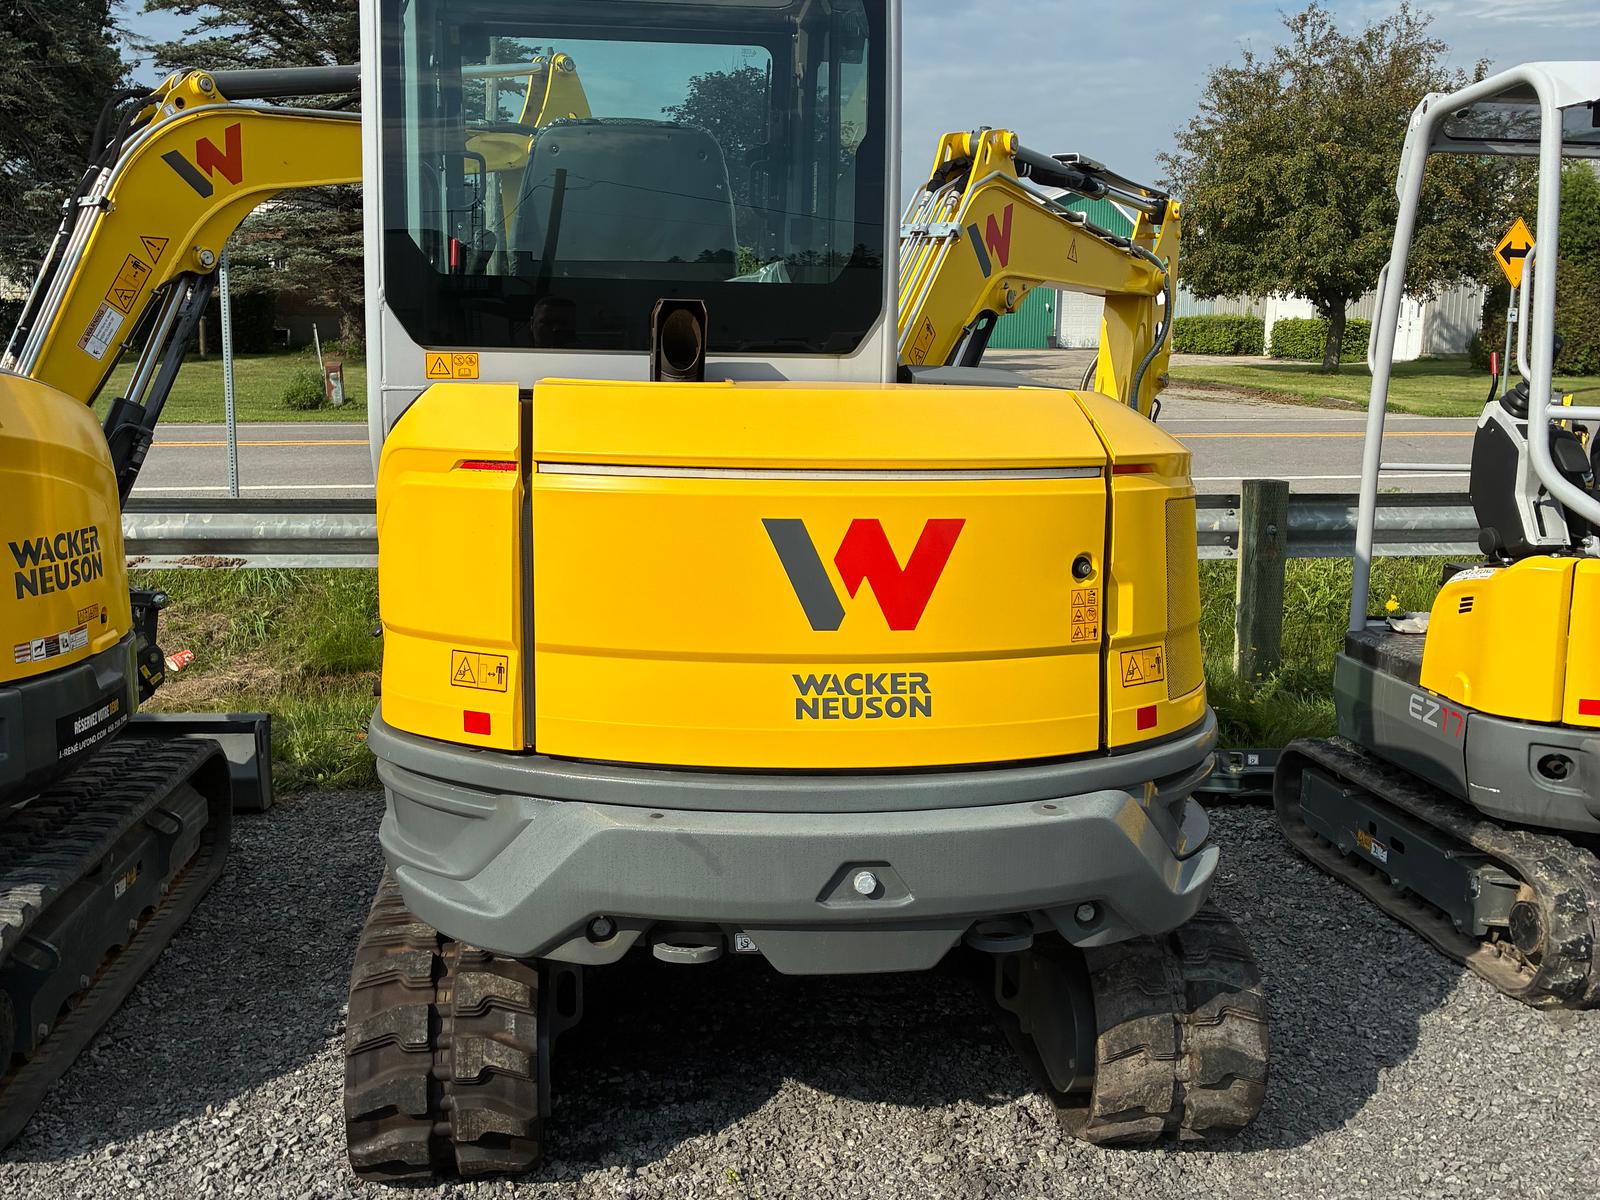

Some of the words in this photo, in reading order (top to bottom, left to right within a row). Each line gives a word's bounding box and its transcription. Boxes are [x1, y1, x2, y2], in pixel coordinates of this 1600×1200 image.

[84, 309, 104, 338] WARNING
[8, 525, 101, 569] WACKER
[14, 552, 103, 600] NEUSON
[761, 518, 967, 631] W
[792, 672, 932, 696] WACKER
[74, 716, 98, 735] RÉSERVEZ
[795, 695, 932, 720] NEUSON
[1408, 693, 1465, 738] EZ17
